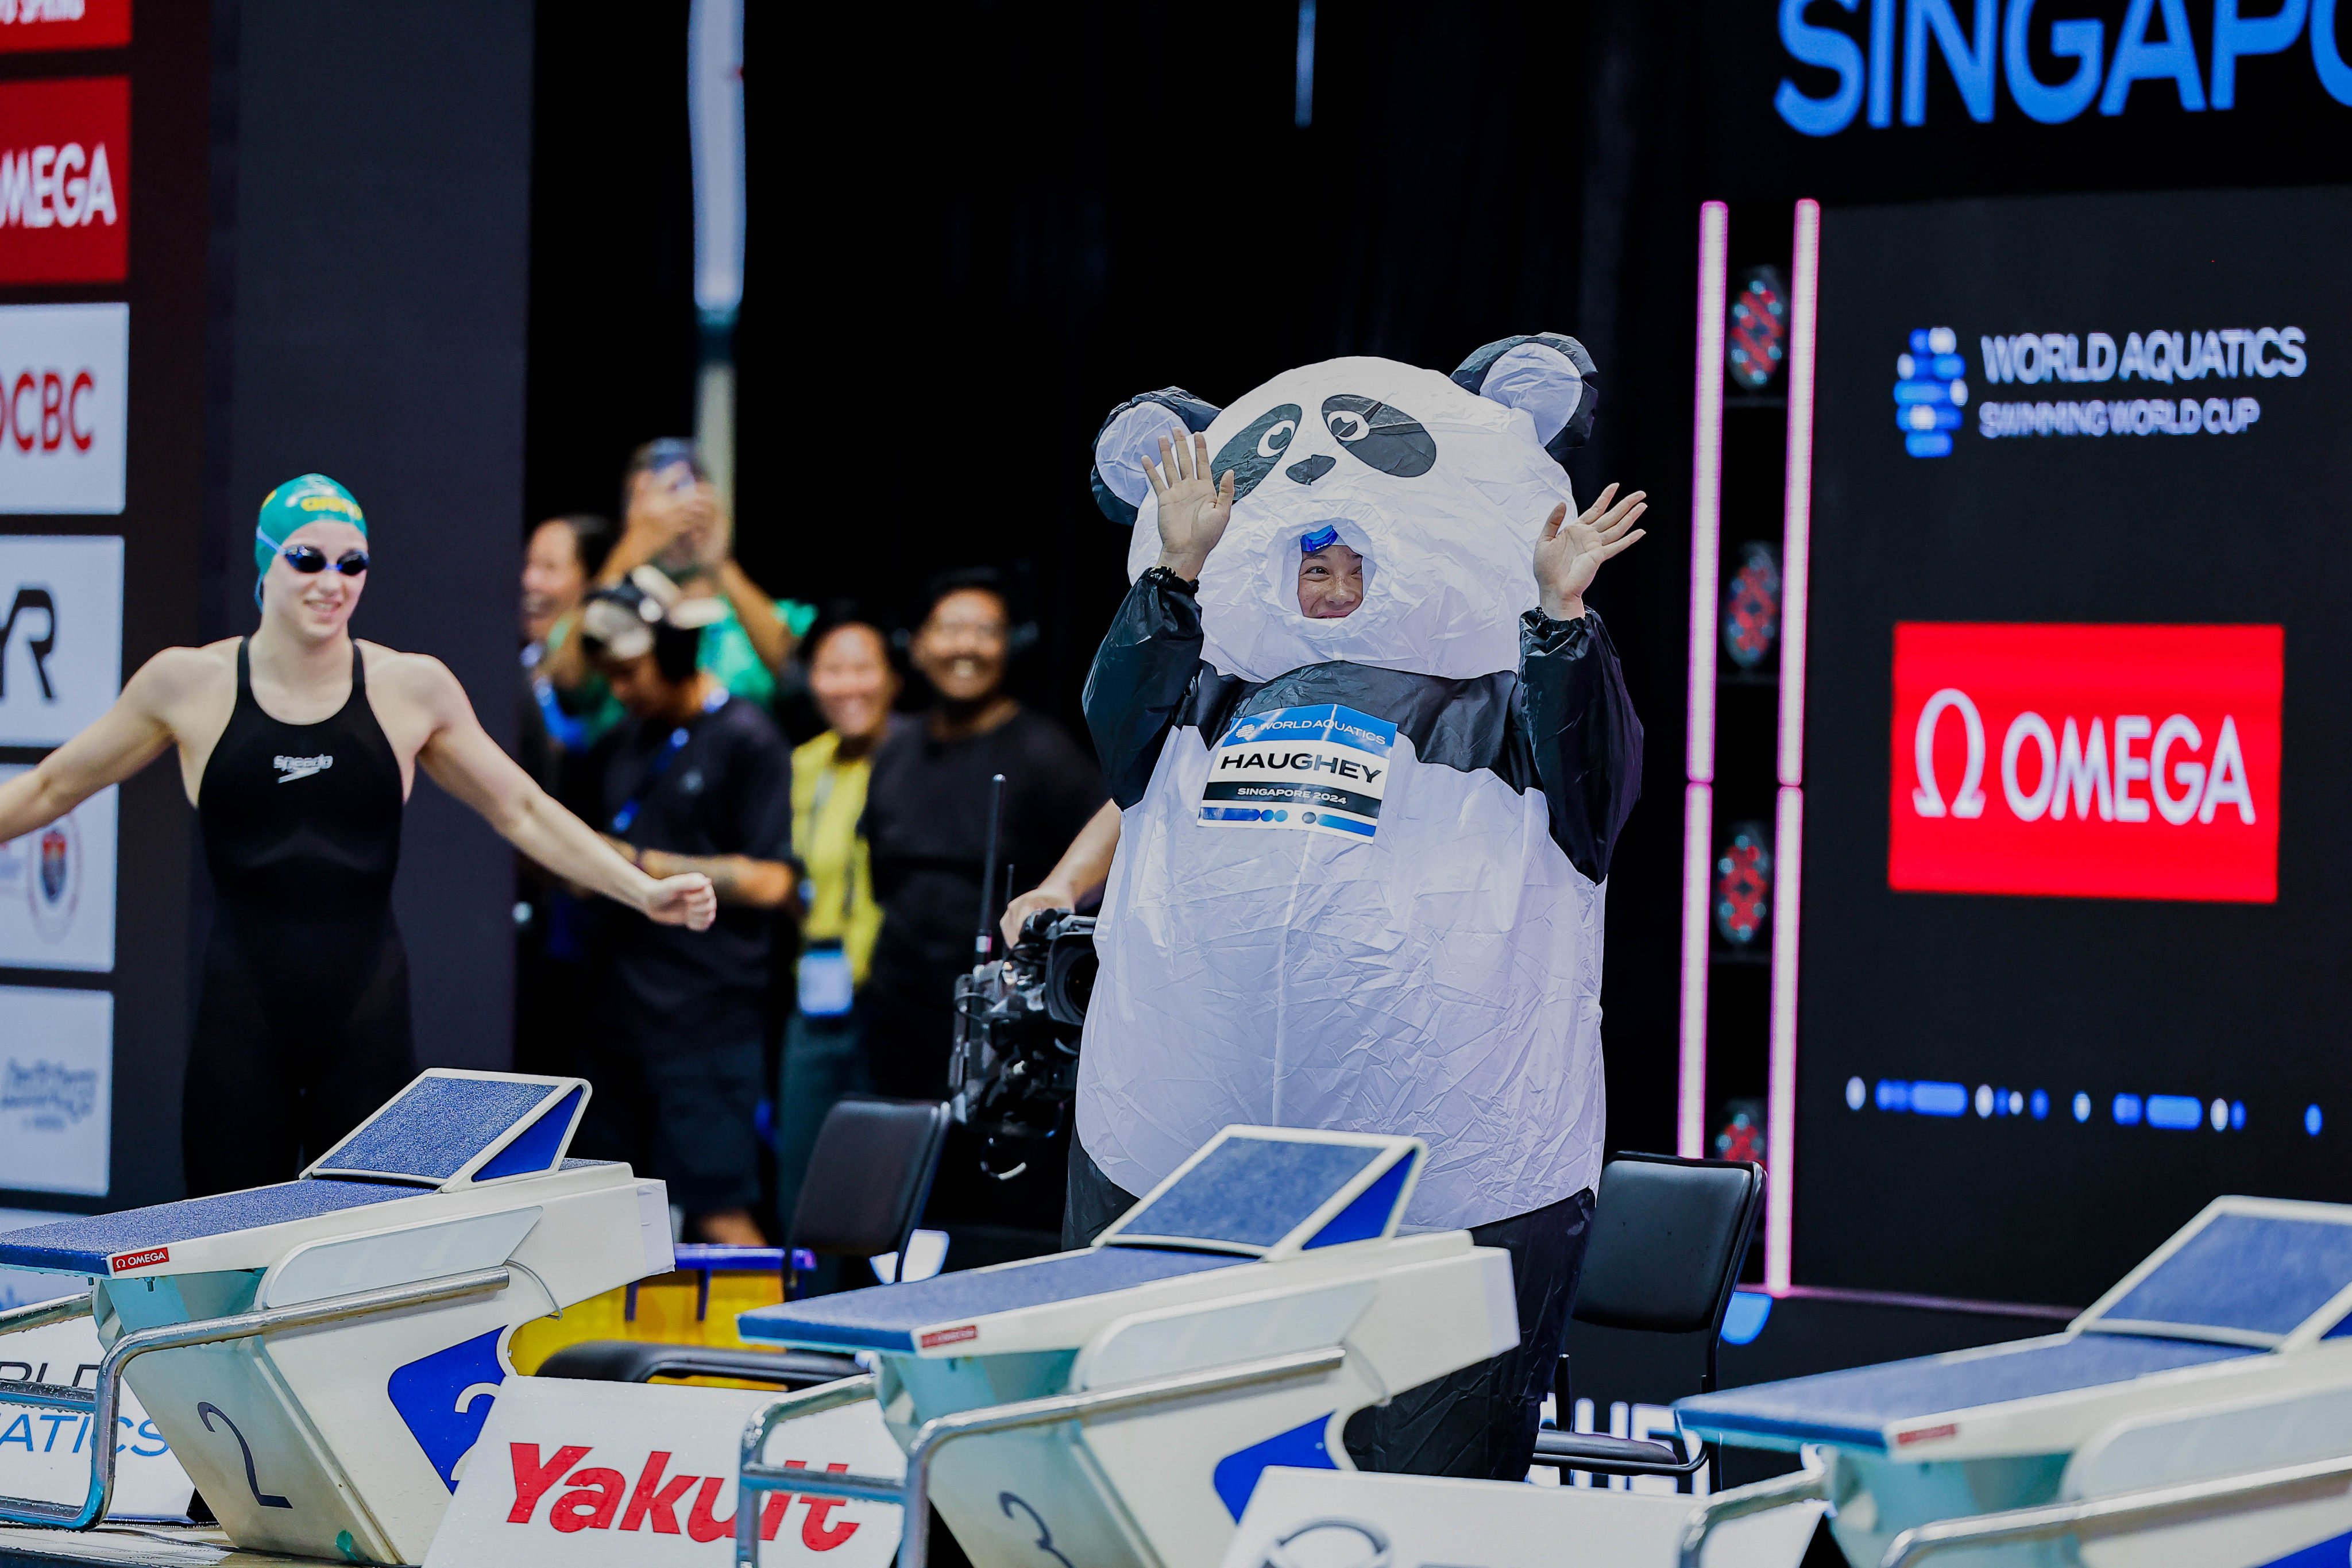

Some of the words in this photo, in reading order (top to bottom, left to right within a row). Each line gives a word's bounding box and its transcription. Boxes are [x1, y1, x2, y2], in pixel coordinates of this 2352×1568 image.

[1980, 332, 2118, 384] WORLD
[2119, 326, 2307, 385] AQUATICS
[0, 371, 94, 452] CBC
[2108, 398, 2202, 436] WORLD
[2202, 396, 2261, 435] CUP
[1260, 720, 1314, 731] WORLD
[1312, 719, 1386, 745] AQUATICS
[1221, 753, 1382, 783] HAUGHEY
[2001, 711, 2257, 825] OMEGA
[1237, 787, 1311, 799] SINGAPORE
[1312, 791, 1347, 805] 2024
[128, 1252, 167, 1266] OMEGA
[197, 1401, 293, 1509] 2
[507, 1442, 861, 1551] Yakult
